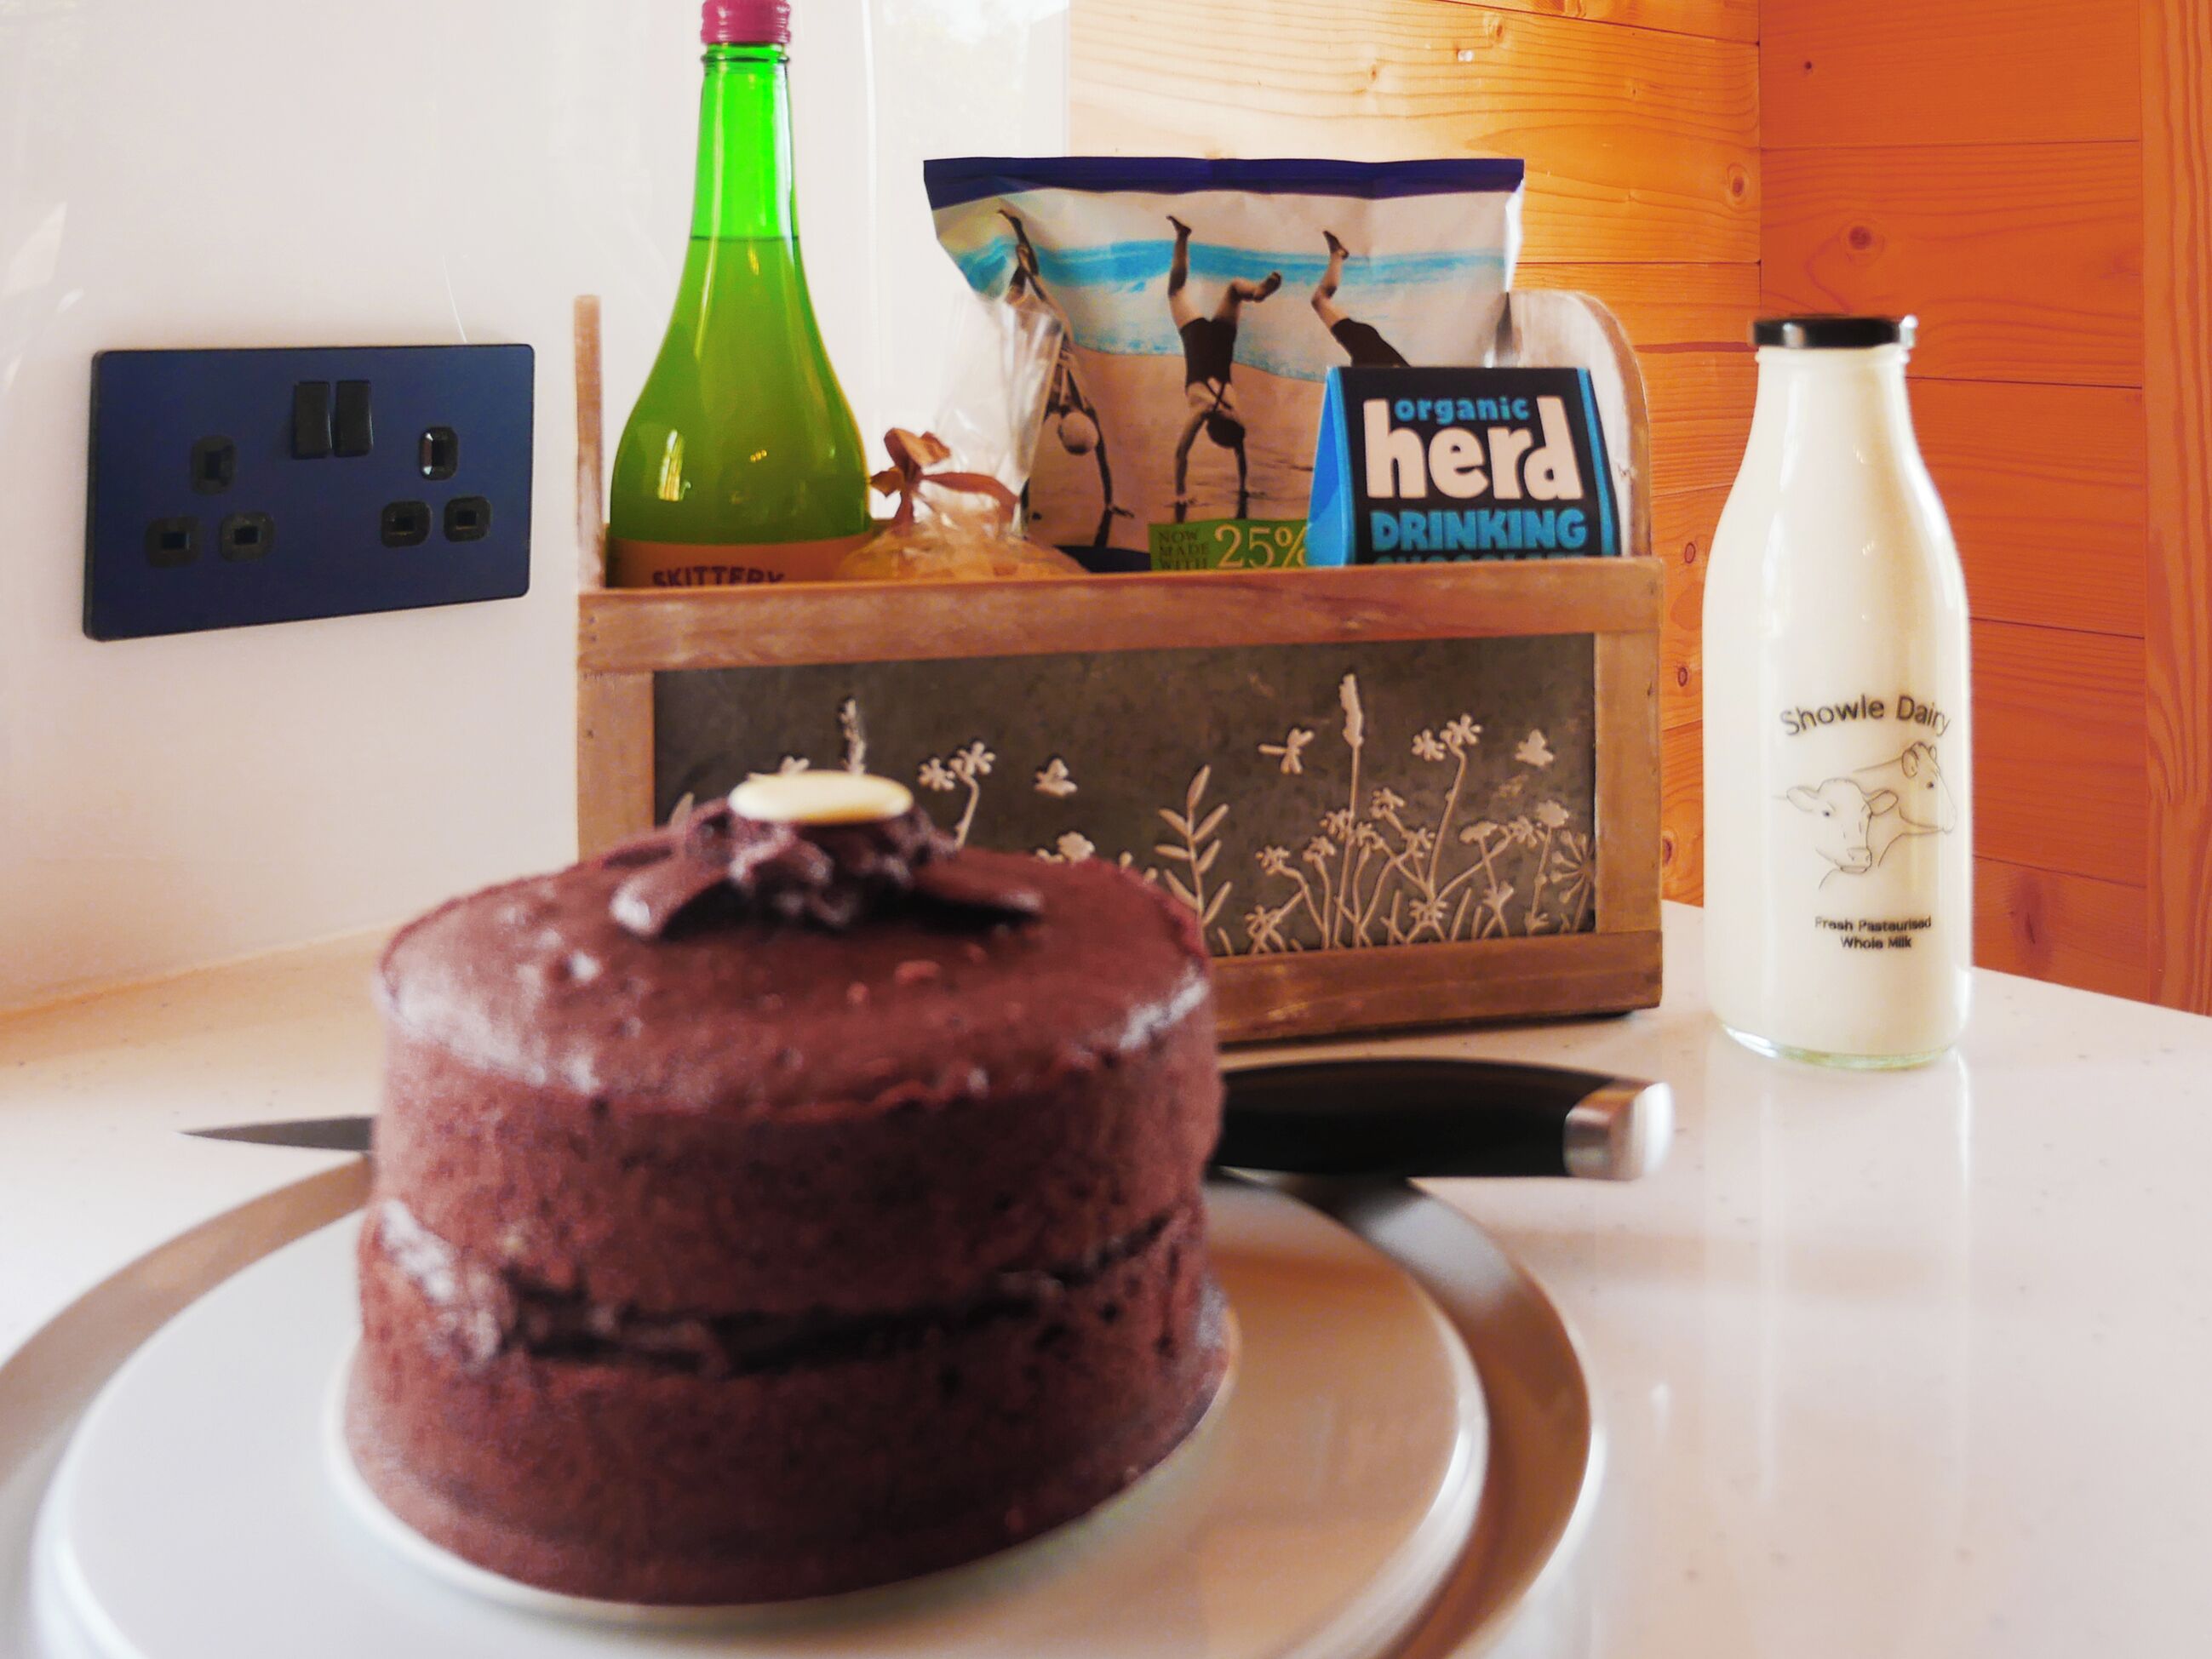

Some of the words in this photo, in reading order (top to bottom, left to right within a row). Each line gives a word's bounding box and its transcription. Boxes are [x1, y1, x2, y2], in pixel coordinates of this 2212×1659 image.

[1394, 398, 1531, 425] organic
[1363, 396, 1584, 501] herd
[1159, 530, 1198, 543] NOW
[1214, 524, 1306, 568] 25%
[1370, 508, 1587, 551] DRINKING
[1780, 694, 1884, 736] Showle
[1895, 695, 1951, 737] Dairy
[1814, 916, 1853, 931] Fresh
[1859, 916, 1931, 931] Pasteurised
[1840, 935, 1883, 950] Whole
[1888, 935, 1911, 949] Milk
